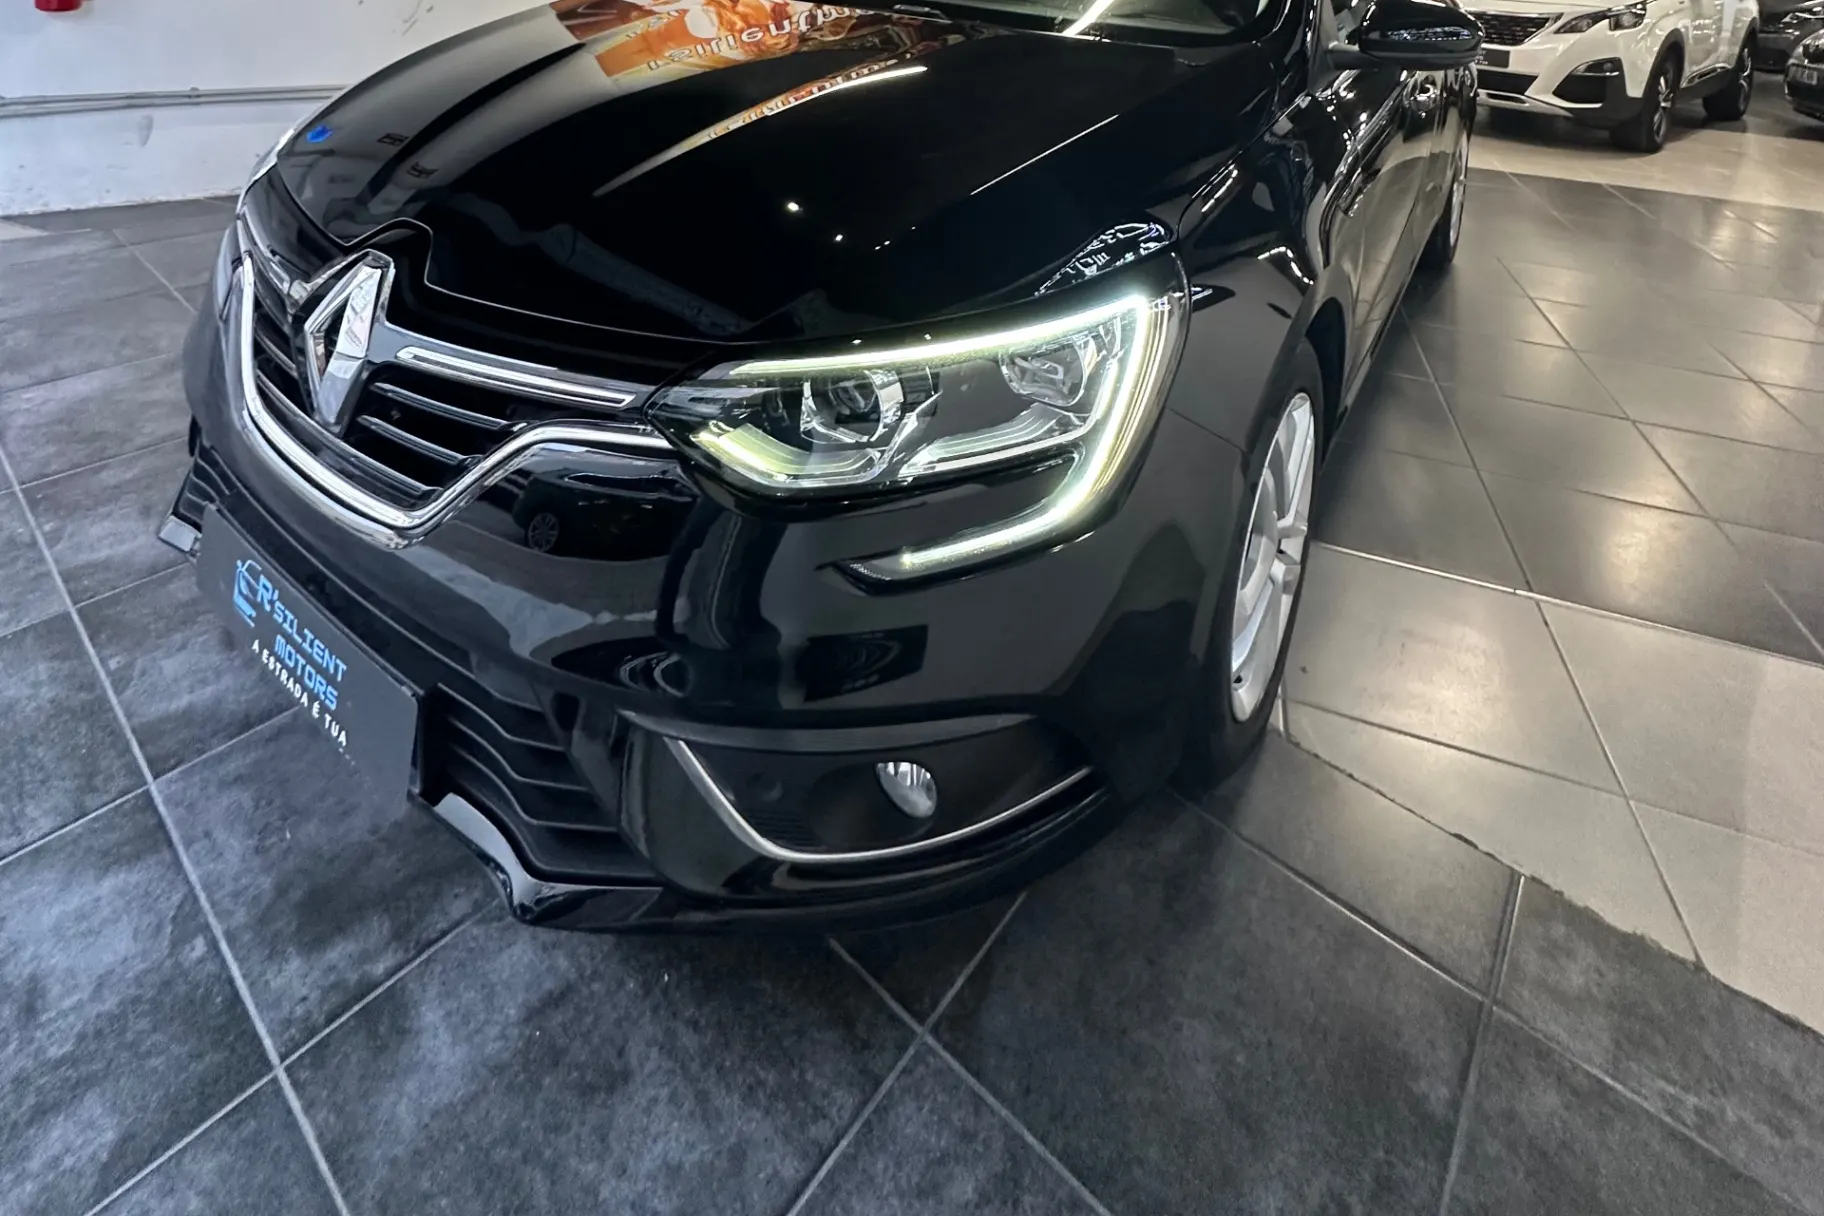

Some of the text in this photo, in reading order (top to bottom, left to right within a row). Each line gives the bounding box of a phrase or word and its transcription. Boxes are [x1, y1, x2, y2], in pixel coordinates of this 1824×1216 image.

[256, 575, 347, 681] R'SILIENT
[274, 634, 338, 711] MOTORS
[252, 639, 348, 747] A ESTRADA É TUA
